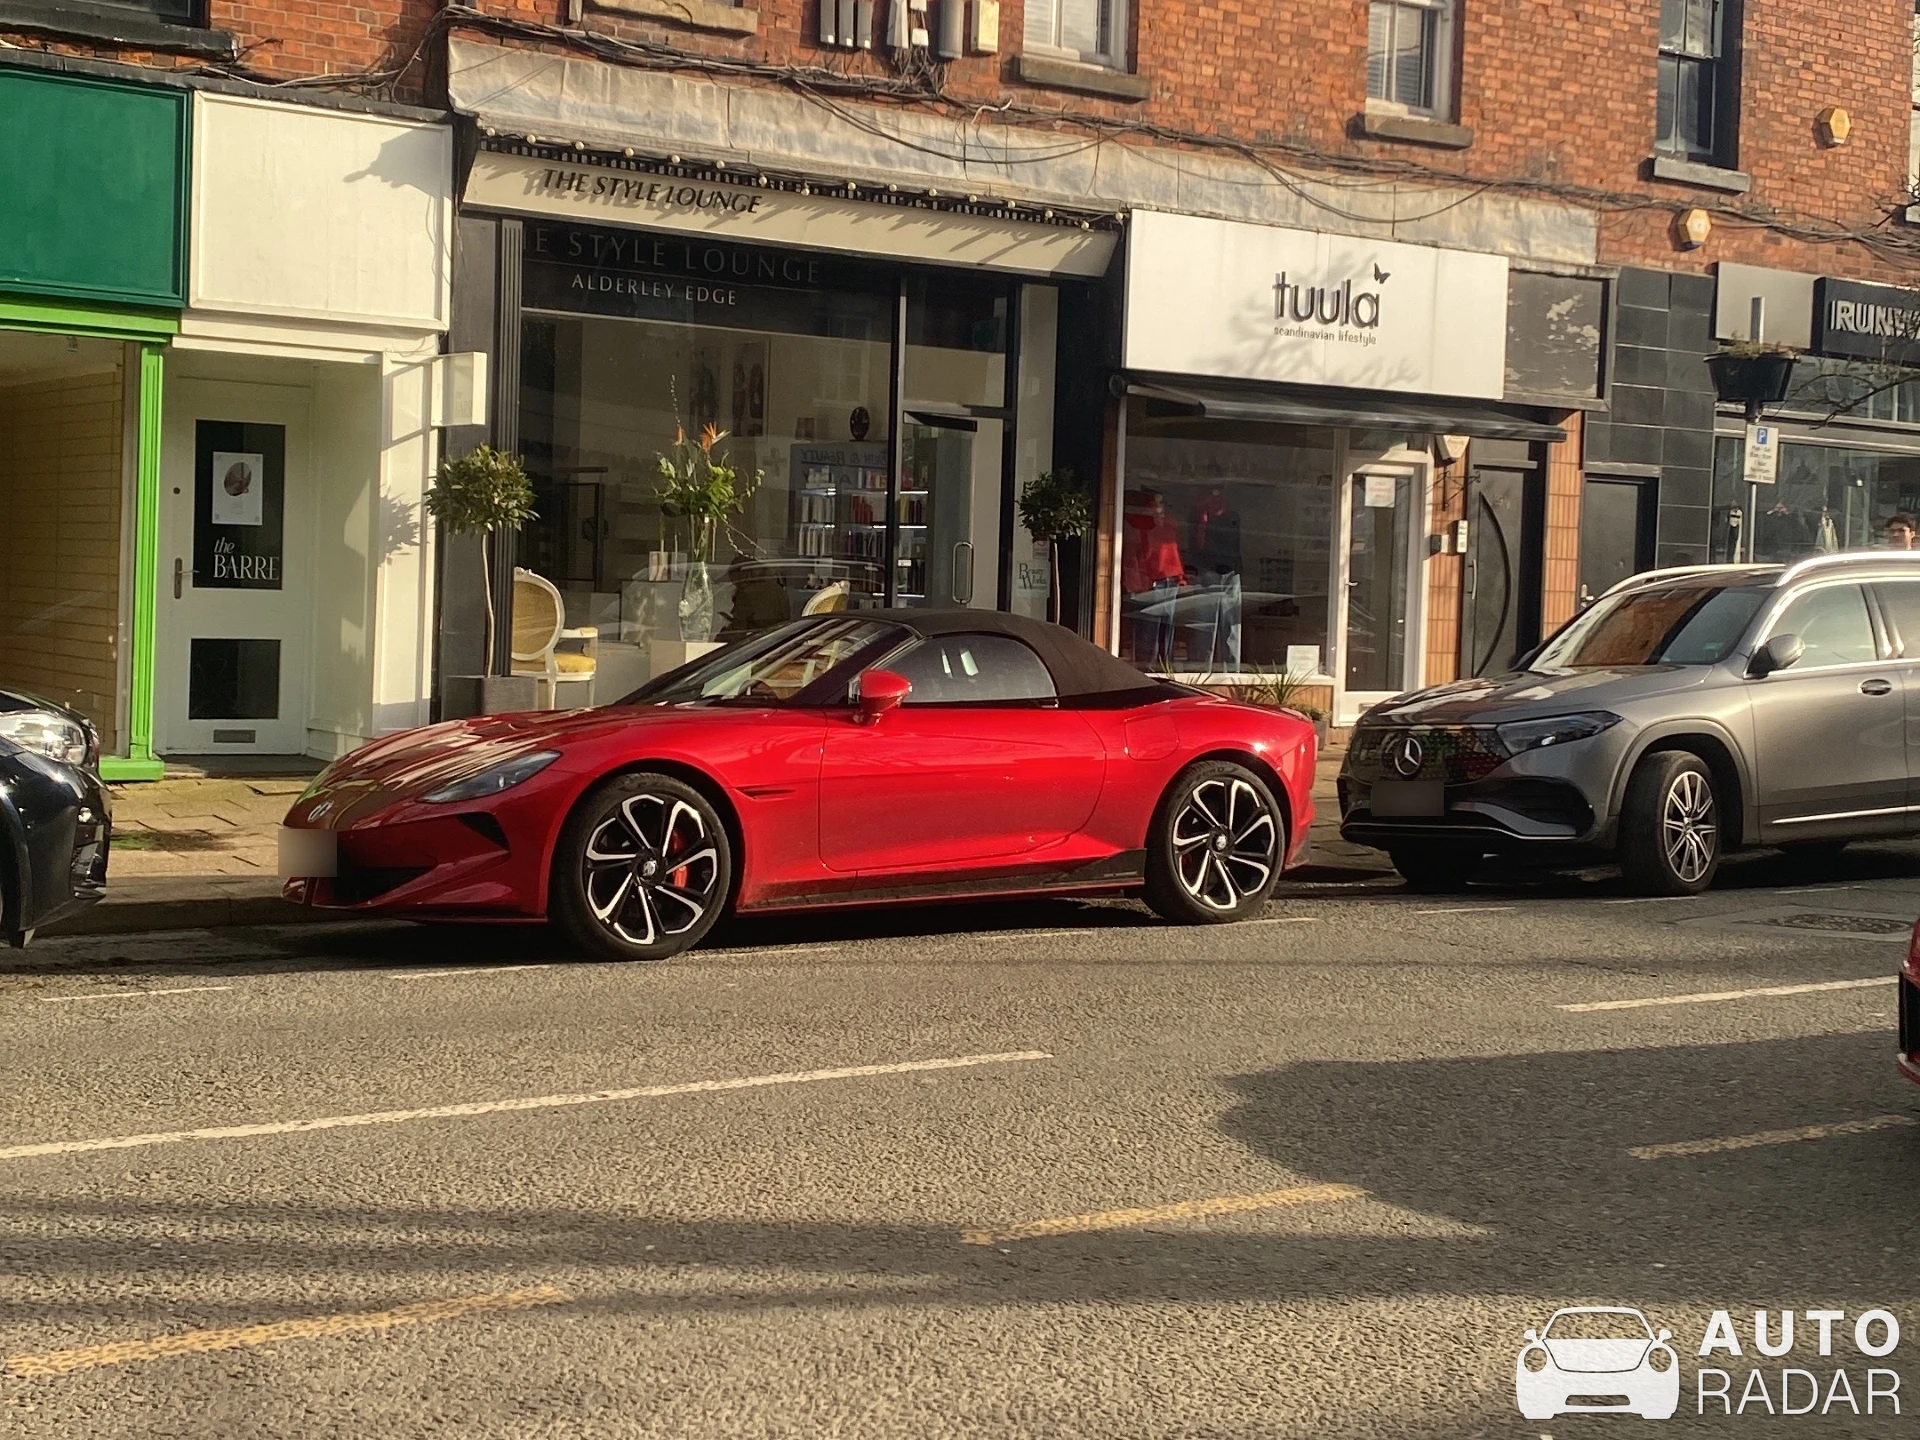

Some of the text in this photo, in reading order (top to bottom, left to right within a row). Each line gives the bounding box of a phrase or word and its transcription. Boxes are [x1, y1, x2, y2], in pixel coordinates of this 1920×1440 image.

[543, 169, 763, 213] THE STYLE LOUNGE
[568, 231, 666, 266] STYLE
[685, 246, 820, 283] LOUNGE
[572, 273, 736, 305] ALDERLEY EDGE
[1273, 271, 1380, 327] tuula
[1273, 326, 1376, 347] scandinavian lifestyle
[213, 537, 235, 554] the
[213, 554, 280, 580] BARRE
